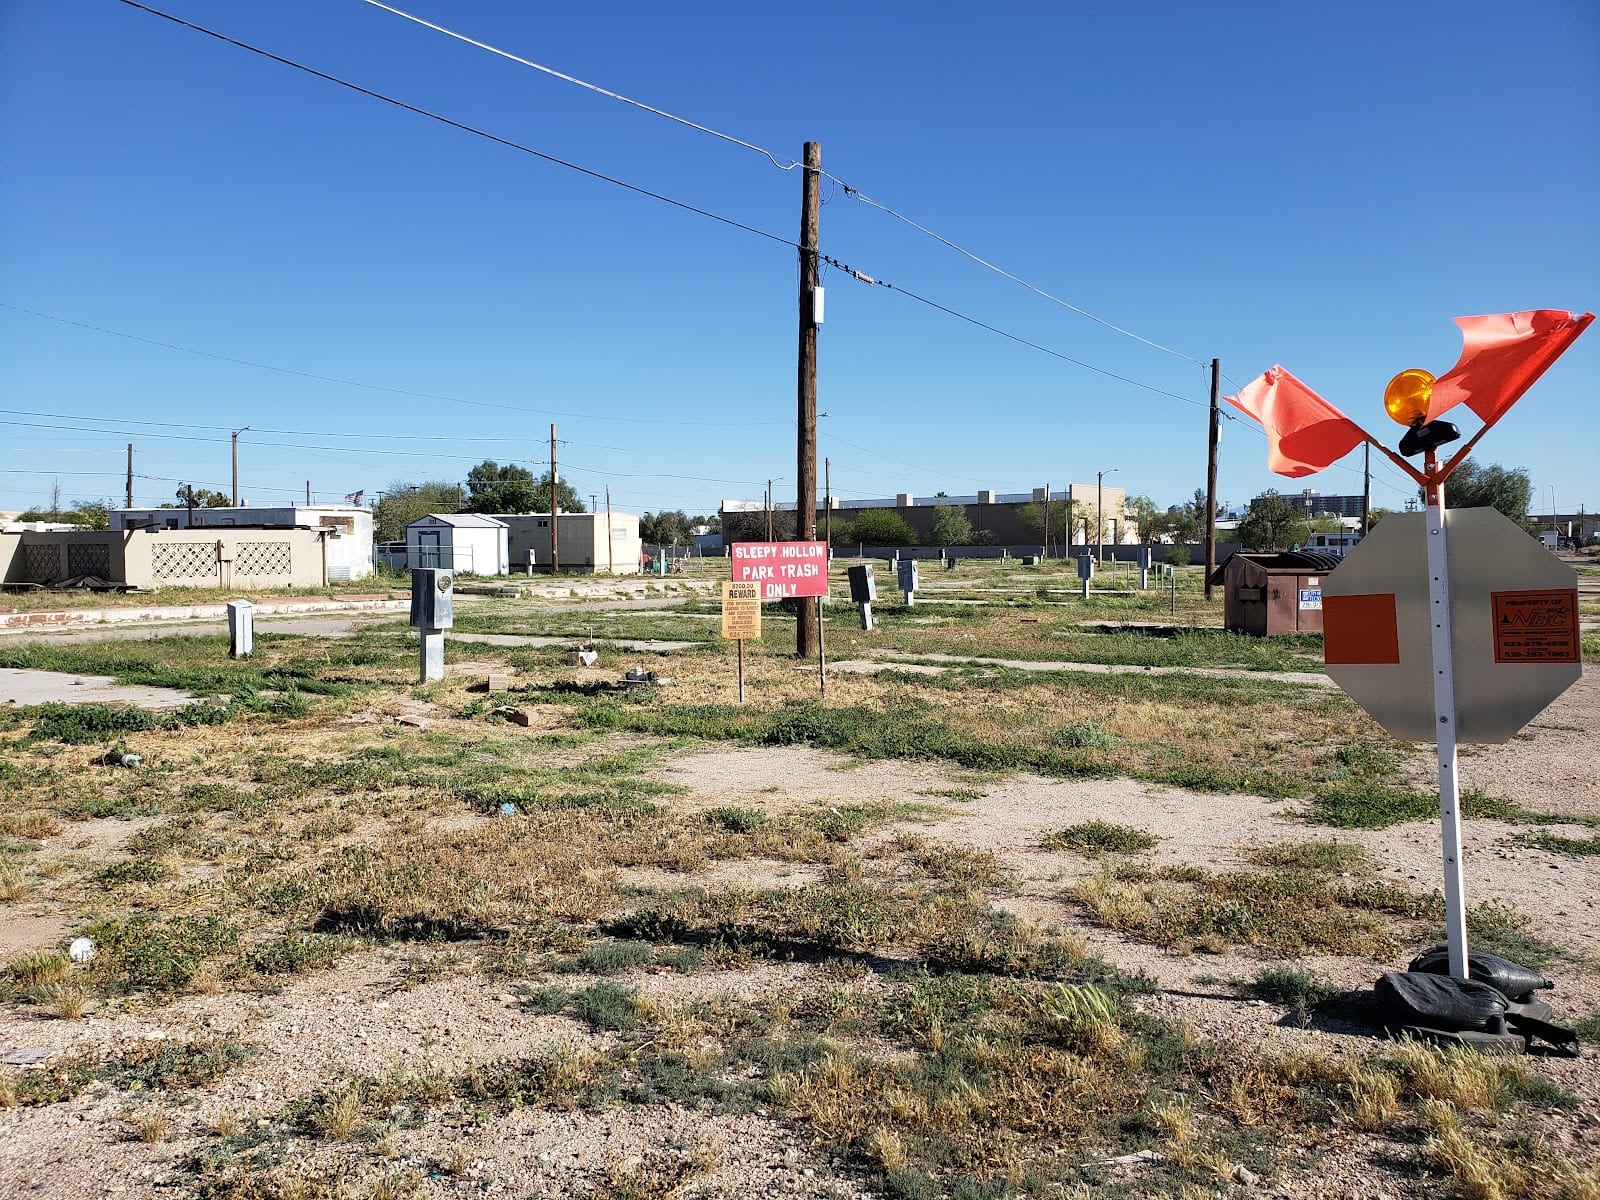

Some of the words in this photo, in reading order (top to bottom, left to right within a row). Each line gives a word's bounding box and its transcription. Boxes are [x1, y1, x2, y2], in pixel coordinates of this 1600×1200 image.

[736, 546, 777, 558] SLEEPY
[782, 546, 823, 558] HOLLOW
[742, 566, 774, 580] PARK
[780, 564, 818, 578] TRASH
[729, 590, 756, 598] REWARD
[766, 584, 796, 598] ONLY
